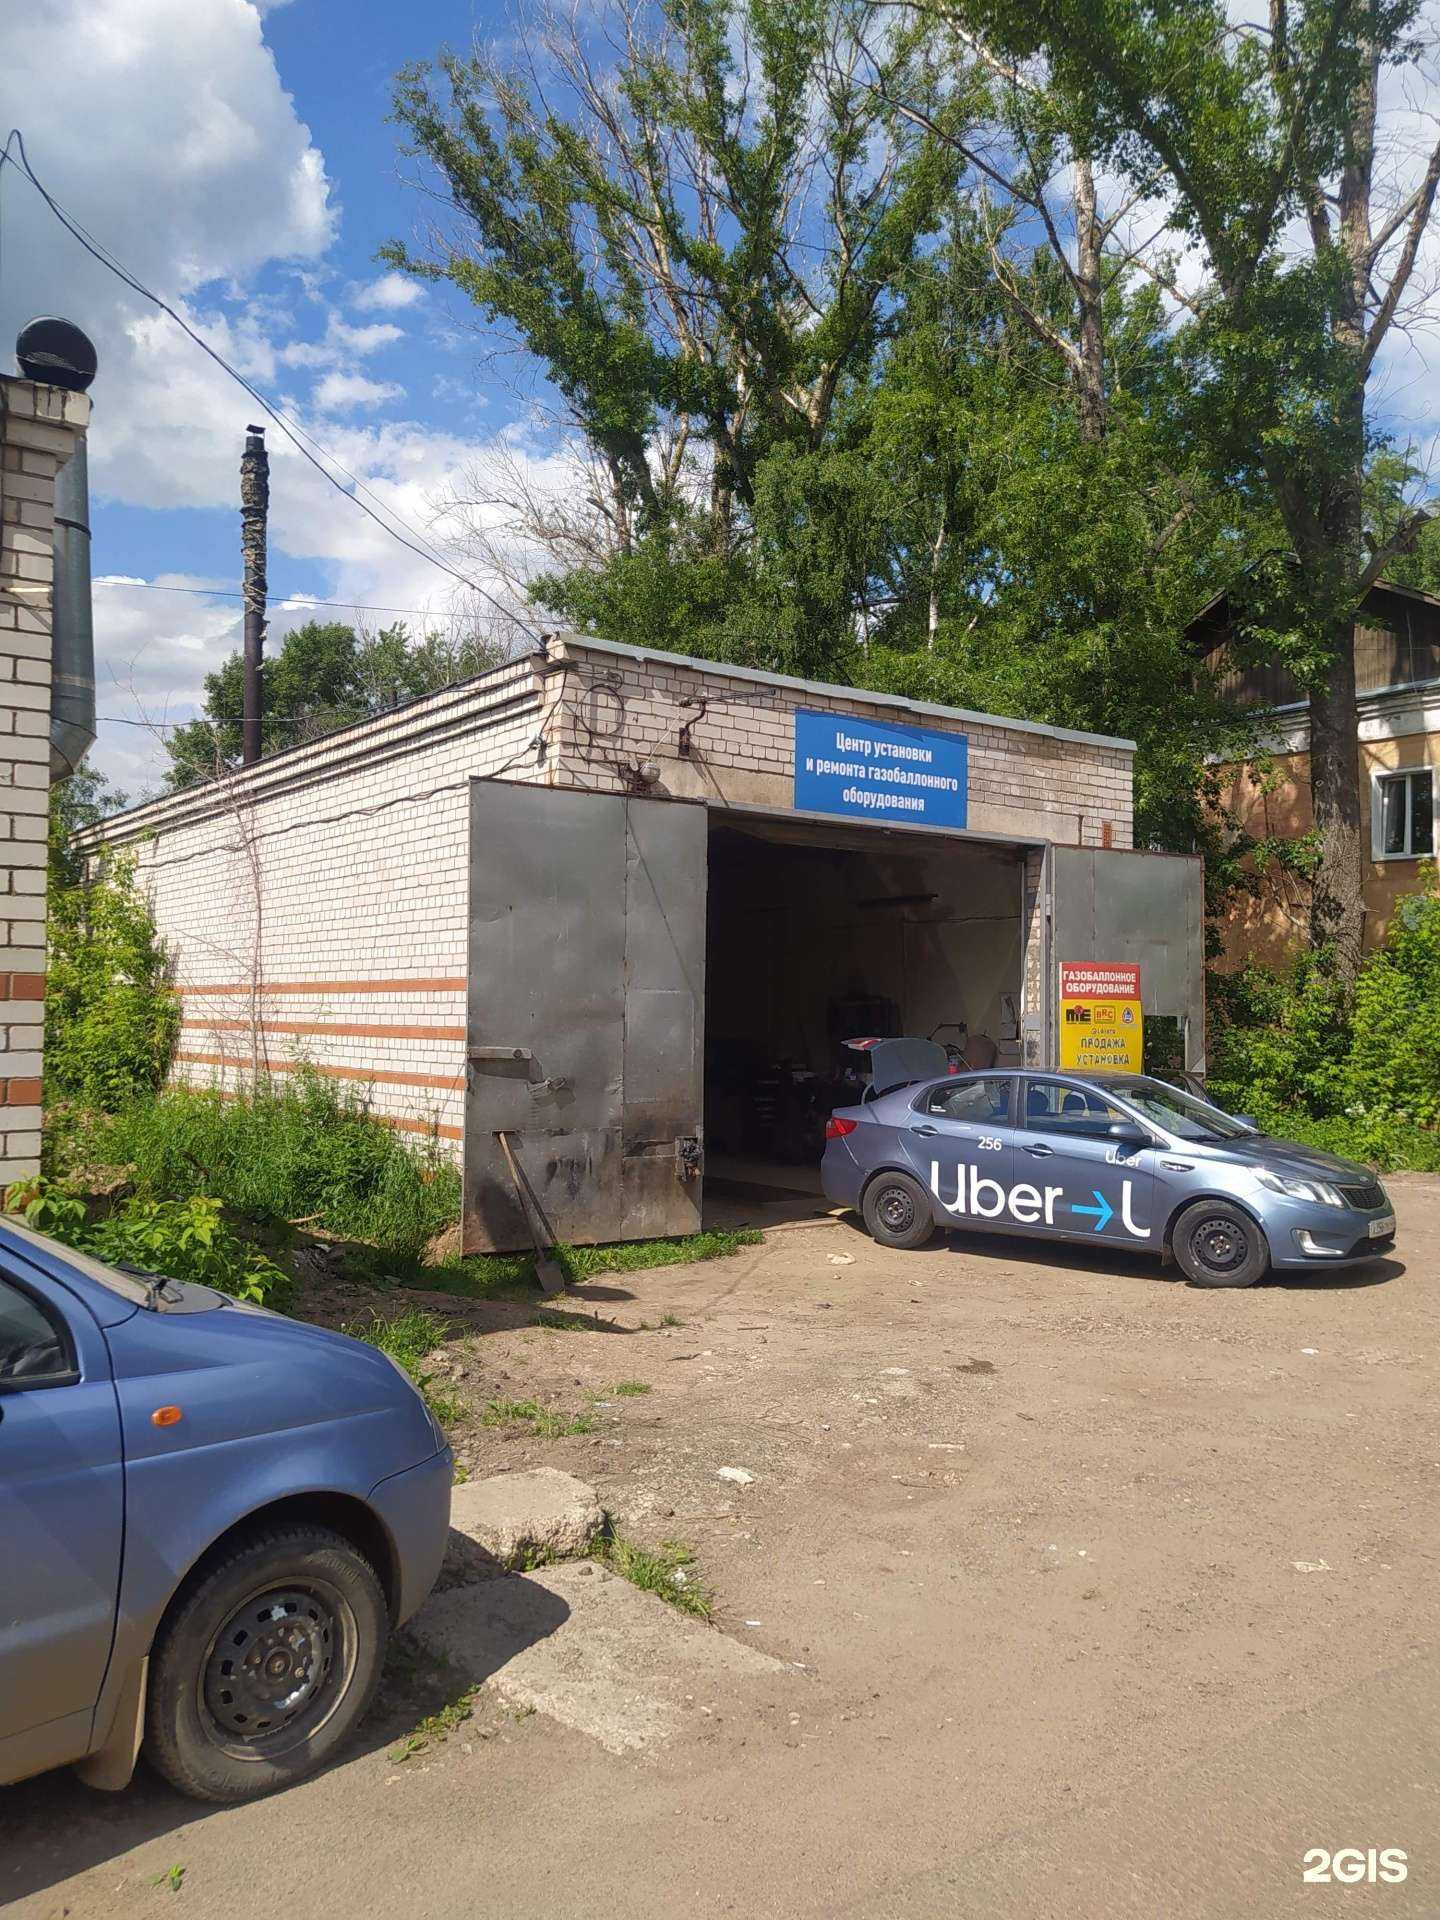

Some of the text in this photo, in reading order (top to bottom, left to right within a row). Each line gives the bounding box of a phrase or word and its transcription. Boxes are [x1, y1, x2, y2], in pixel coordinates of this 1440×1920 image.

[836, 732, 933, 763] Центр установки
[806, 757, 958, 791] и ремонта газобаллонного
[843, 787, 925, 812] оборудования
[1063, 970, 1136, 983] ГАЗОБАЛЛОННОЕ
[1066, 983, 1135, 995] ОБОРУДОВАНИЕ
[1081, 1038, 1126, 1049] ПРОДАЖА
[1076, 1054, 1130, 1065] УСТАНОВКА
[977, 1136, 1003, 1151] 256
[930, 1160, 1063, 1225] Uber
